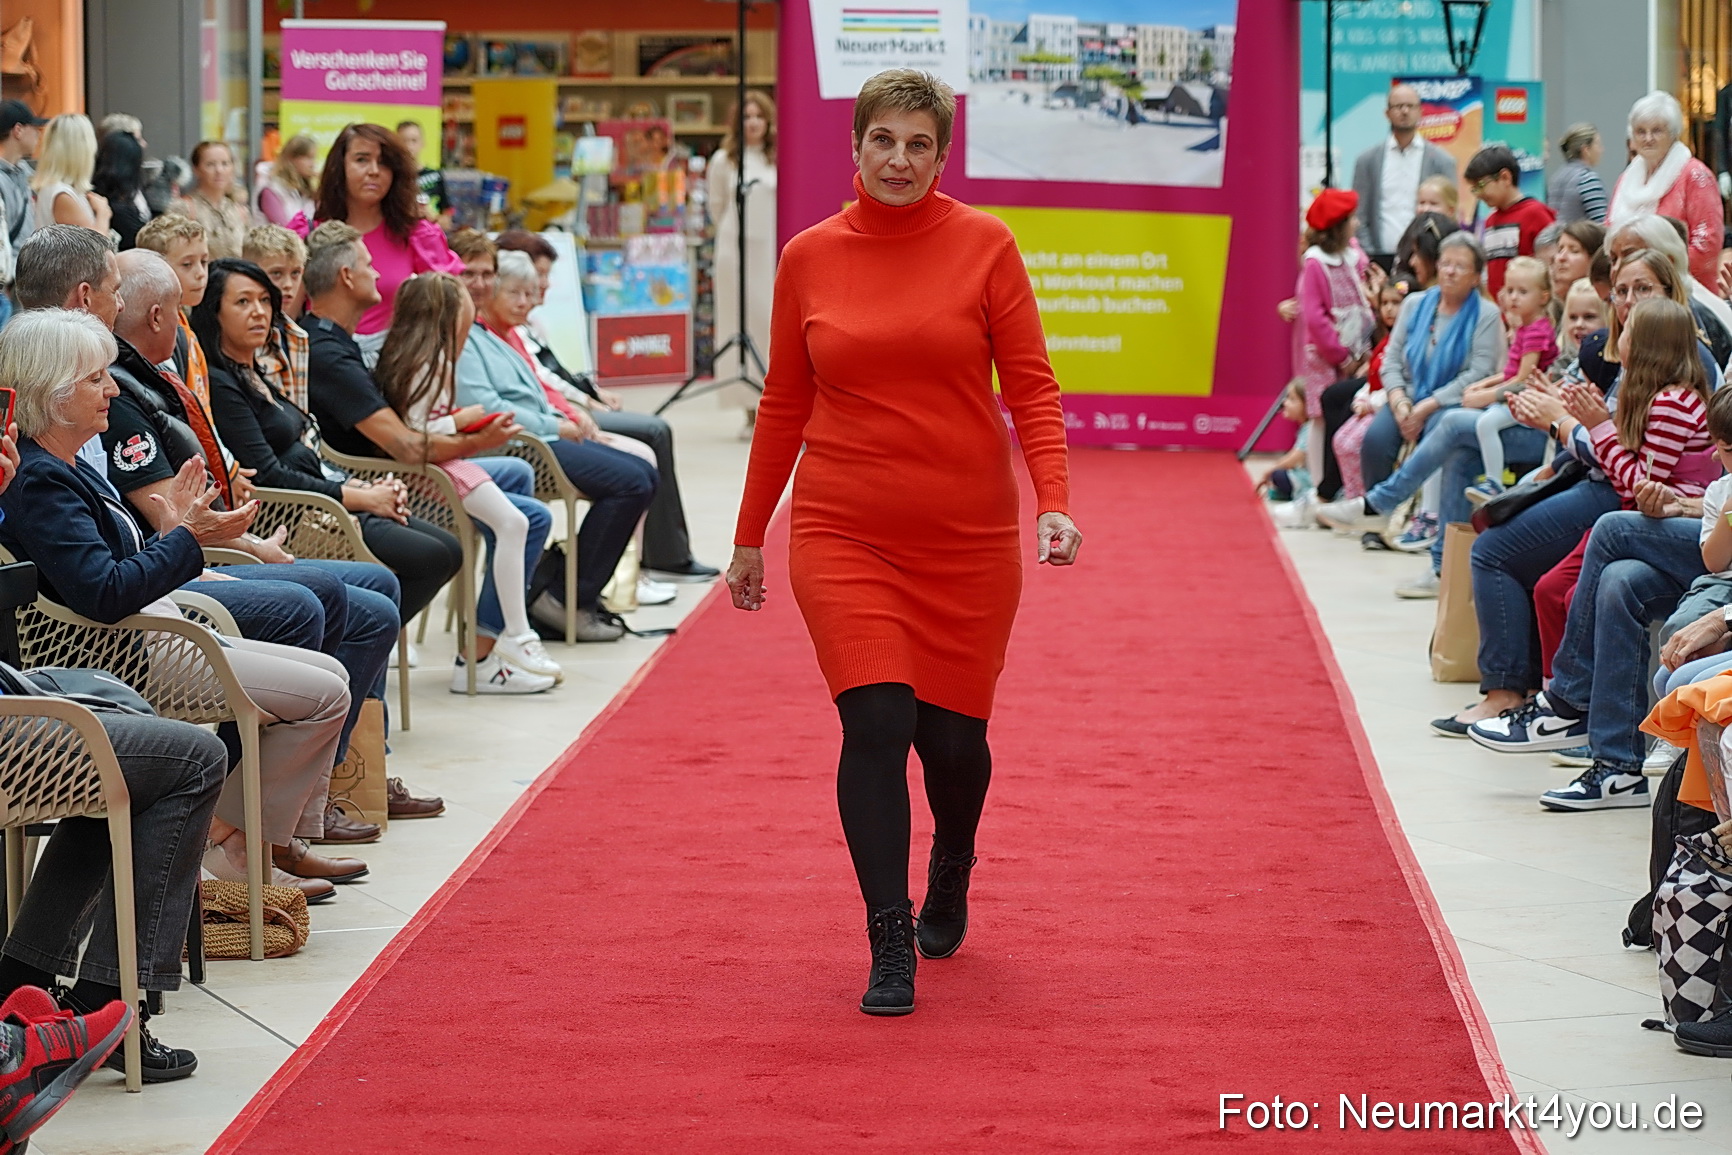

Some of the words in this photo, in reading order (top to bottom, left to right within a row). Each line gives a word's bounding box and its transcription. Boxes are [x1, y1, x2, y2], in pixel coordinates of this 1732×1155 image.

[835, 38, 945, 53] NeuerMarkt
[290, 49, 399, 69] Verschenken
[400, 50, 428, 70] Sie
[325, 70, 427, 91] Gutscheine!
[1085, 251, 1139, 270] einem
[1140, 251, 1168, 270] Ort
[1117, 275, 1183, 291] machen
[1046, 333, 1122, 351] önntest!
